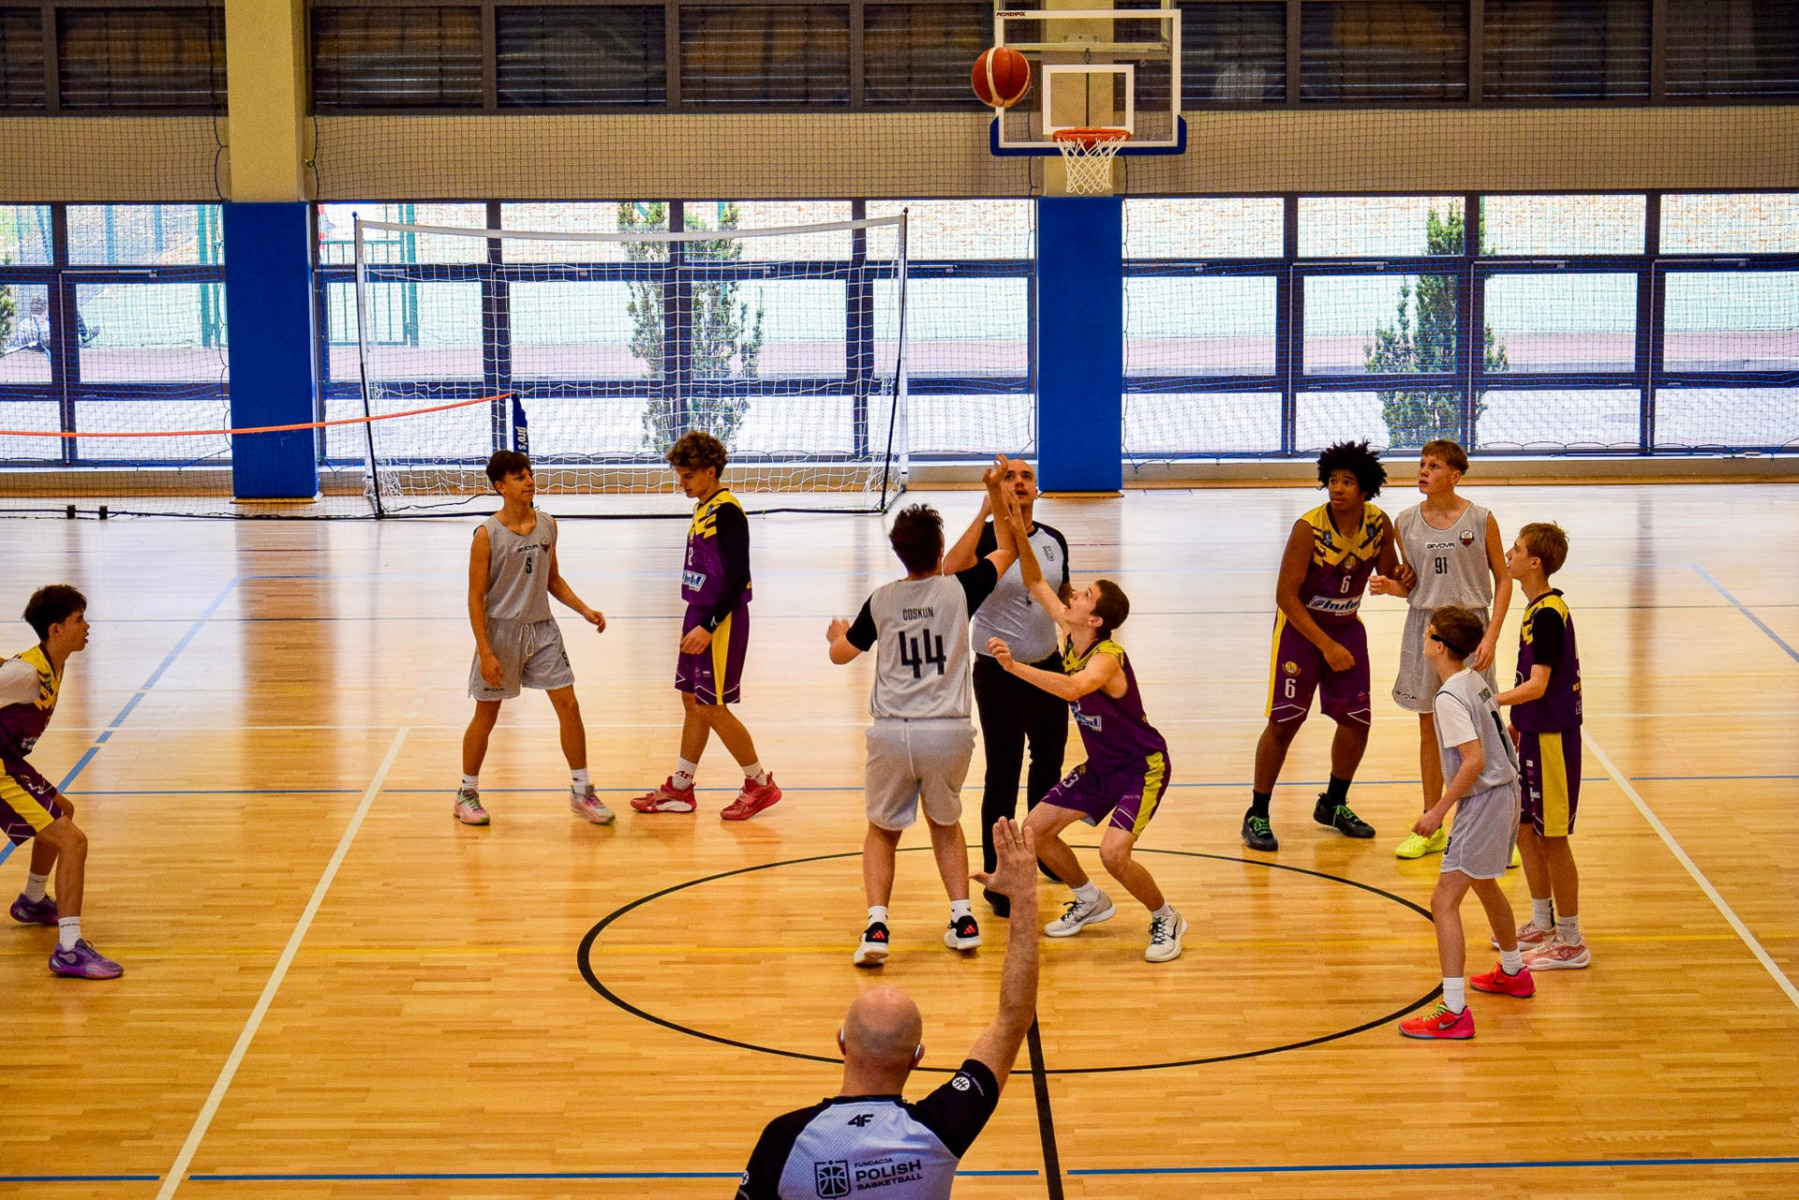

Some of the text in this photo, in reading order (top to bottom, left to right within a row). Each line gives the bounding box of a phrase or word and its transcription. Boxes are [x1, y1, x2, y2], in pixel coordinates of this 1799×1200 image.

[1434, 556, 1448, 574] 91
[1340, 575, 1352, 594] 6
[902, 606, 935, 620] COSKUN
[898, 628, 947, 679] 44
[1284, 678, 1296, 699] 6
[847, 1113, 874, 1127] 4F
[856, 1160, 922, 1182] POLISH
[857, 1173, 922, 1191] BASKETBALL
